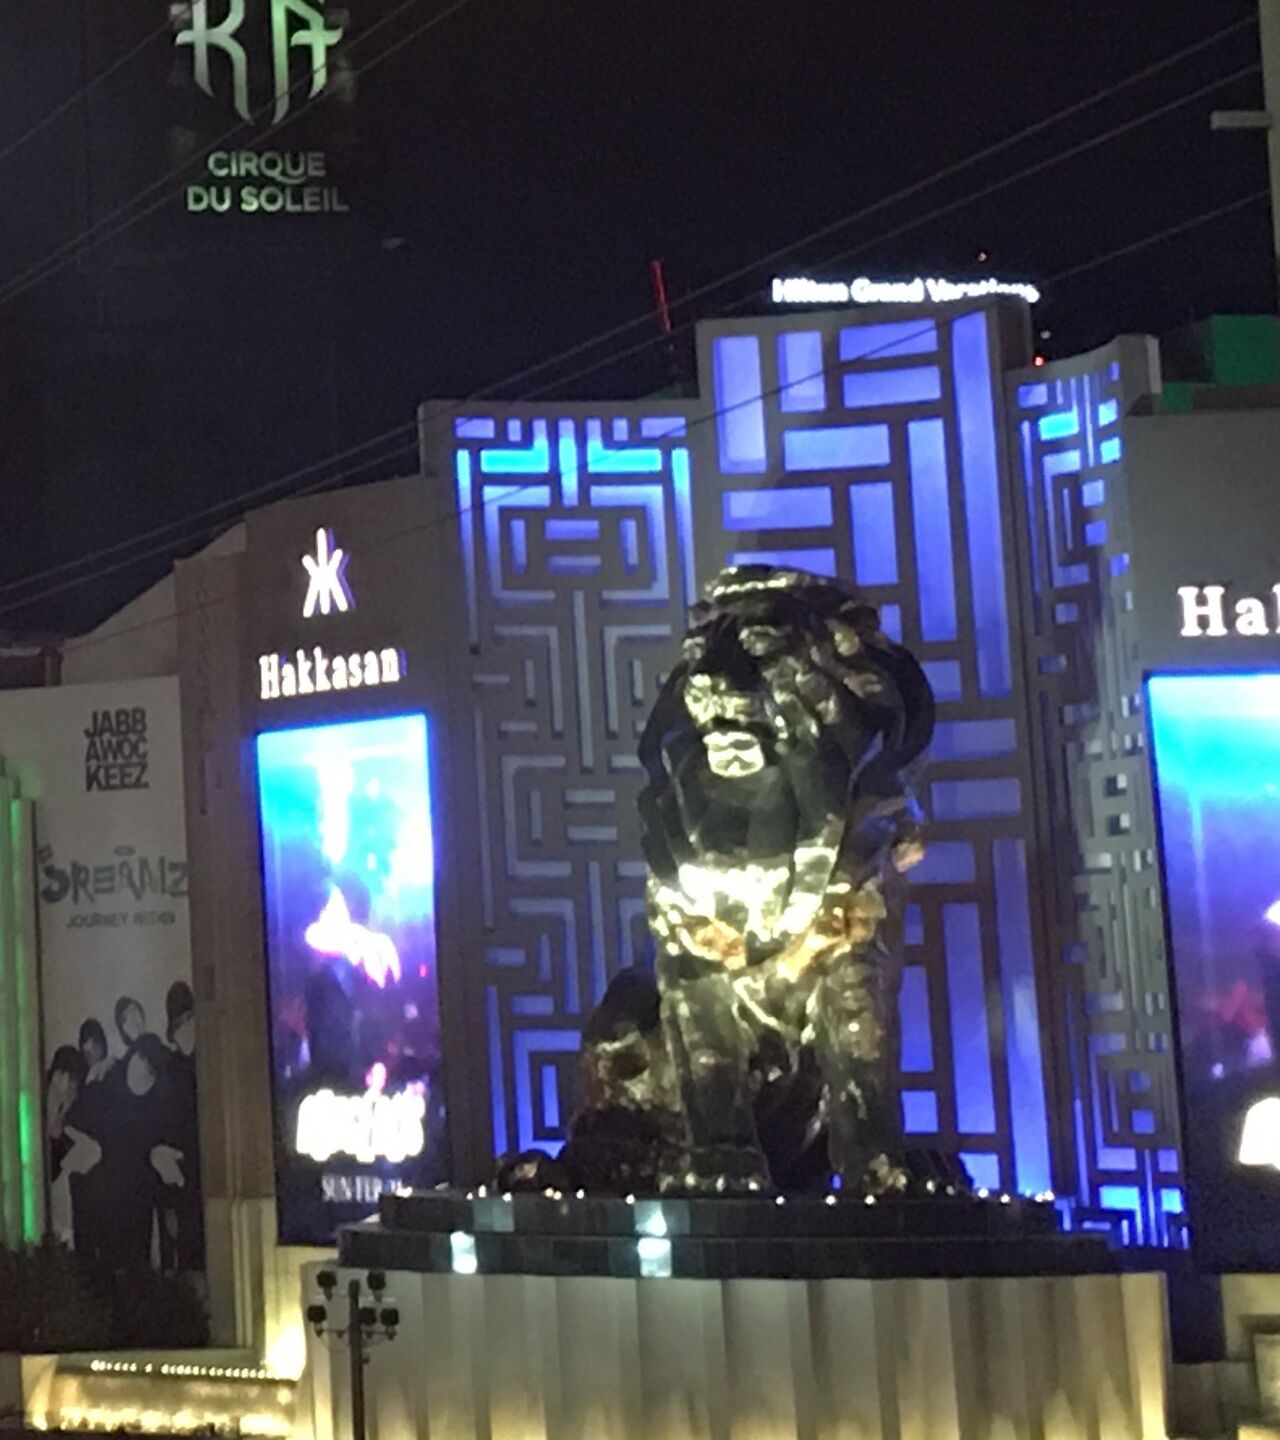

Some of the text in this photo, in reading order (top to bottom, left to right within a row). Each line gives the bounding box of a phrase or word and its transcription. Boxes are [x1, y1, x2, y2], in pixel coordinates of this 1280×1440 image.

[207, 151, 326, 184] CIRQUE
[187, 186, 349, 212] DU SOLEIL
[259, 646, 400, 701] Hakkasan
[84, 707, 148, 738] JABB
[86, 763, 149, 792] KEEZ
